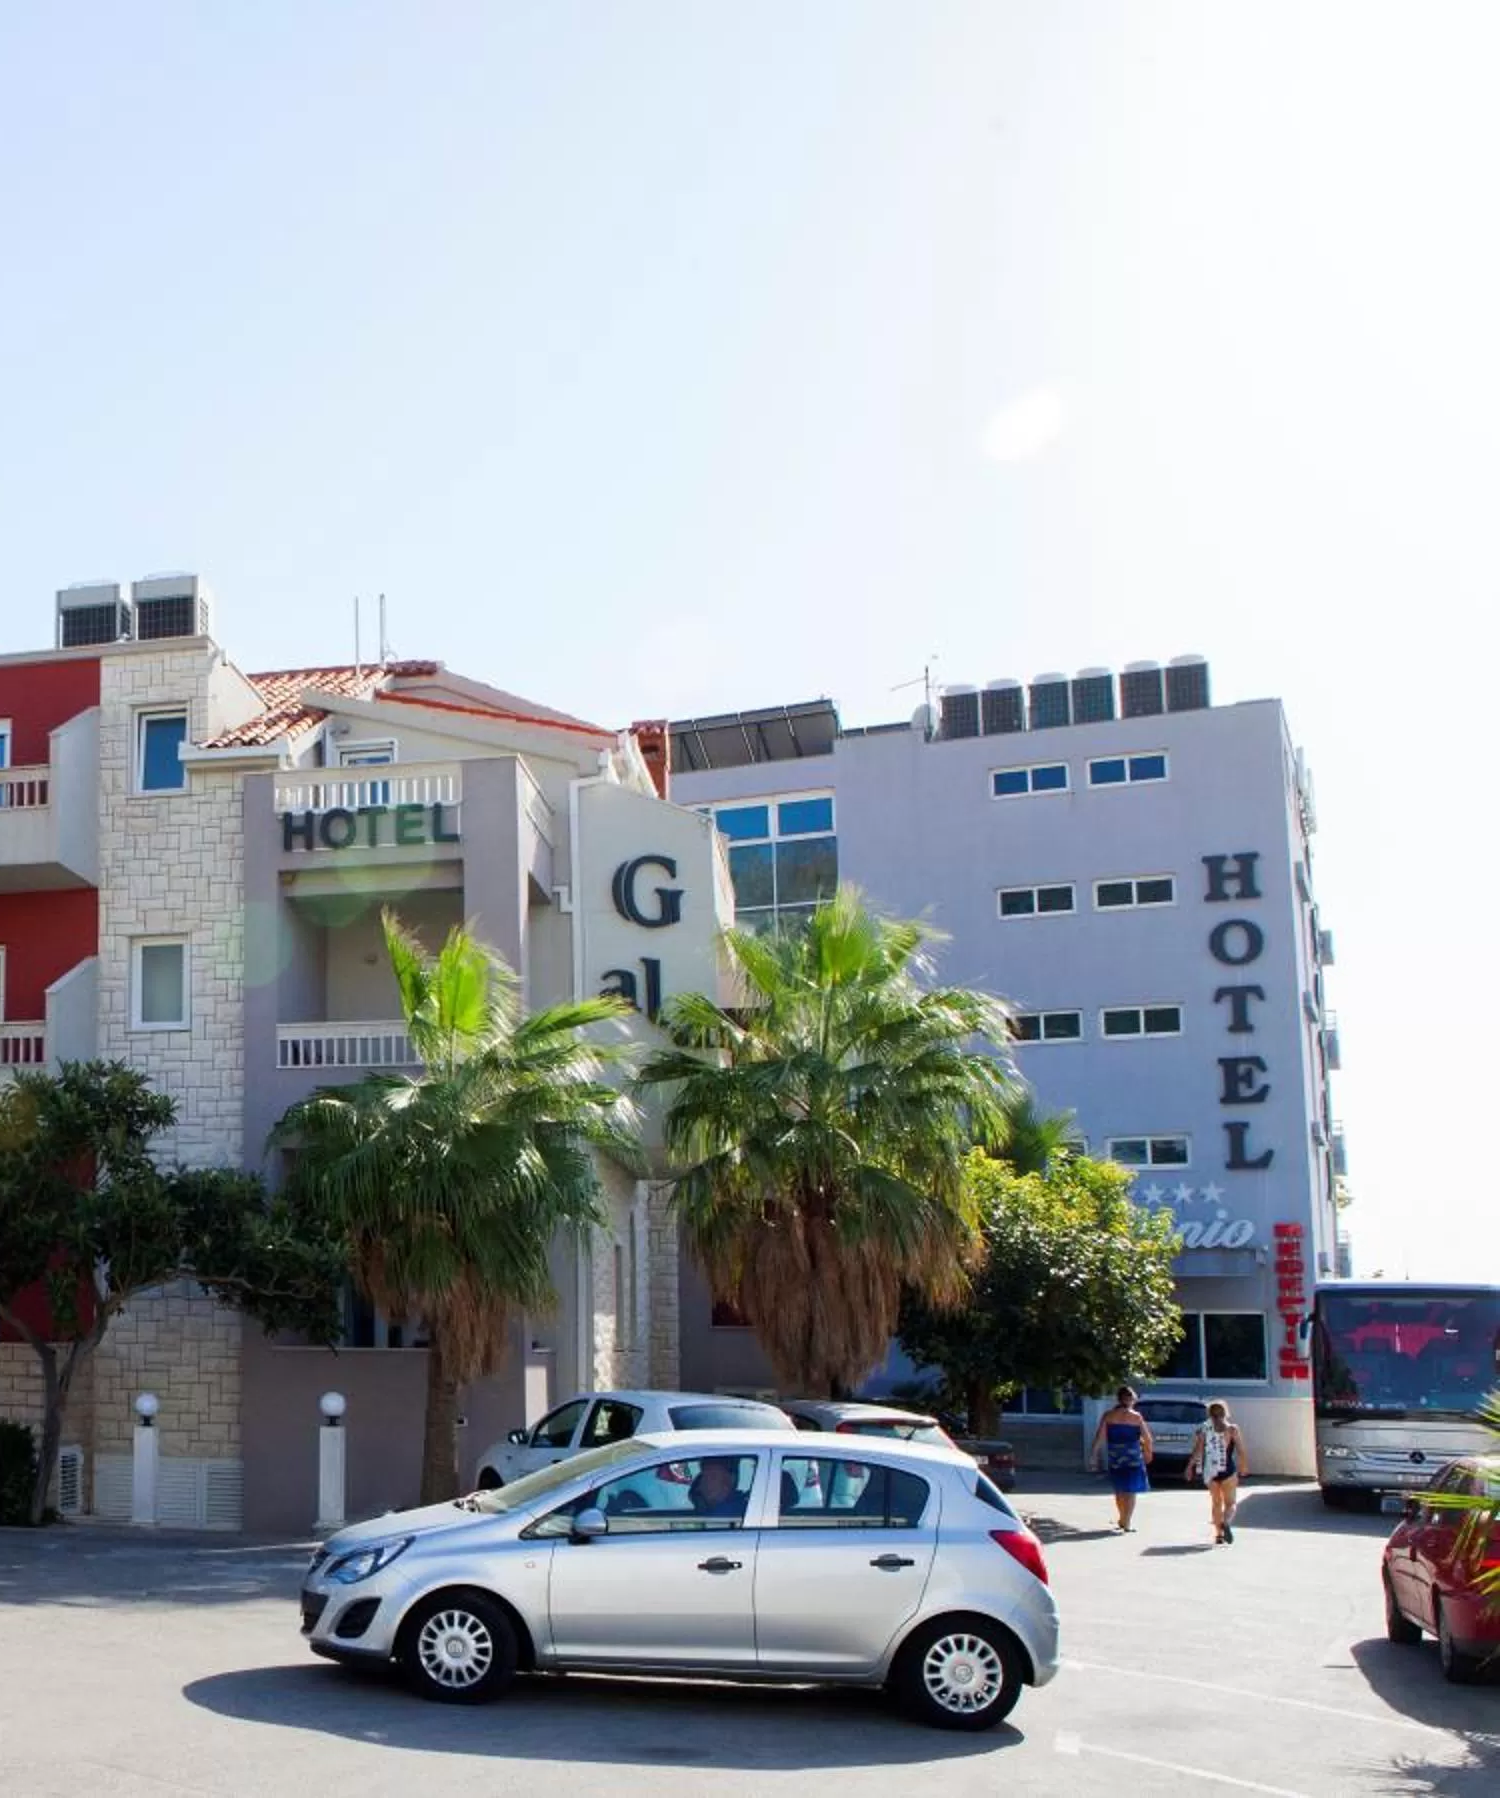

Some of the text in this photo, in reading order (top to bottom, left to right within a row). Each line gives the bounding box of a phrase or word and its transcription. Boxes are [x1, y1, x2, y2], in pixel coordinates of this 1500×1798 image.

[281, 802, 460, 852] HOTEL
[1201, 851, 1274, 1170] HOTEL
[1177, 1208, 1254, 1248] nio
